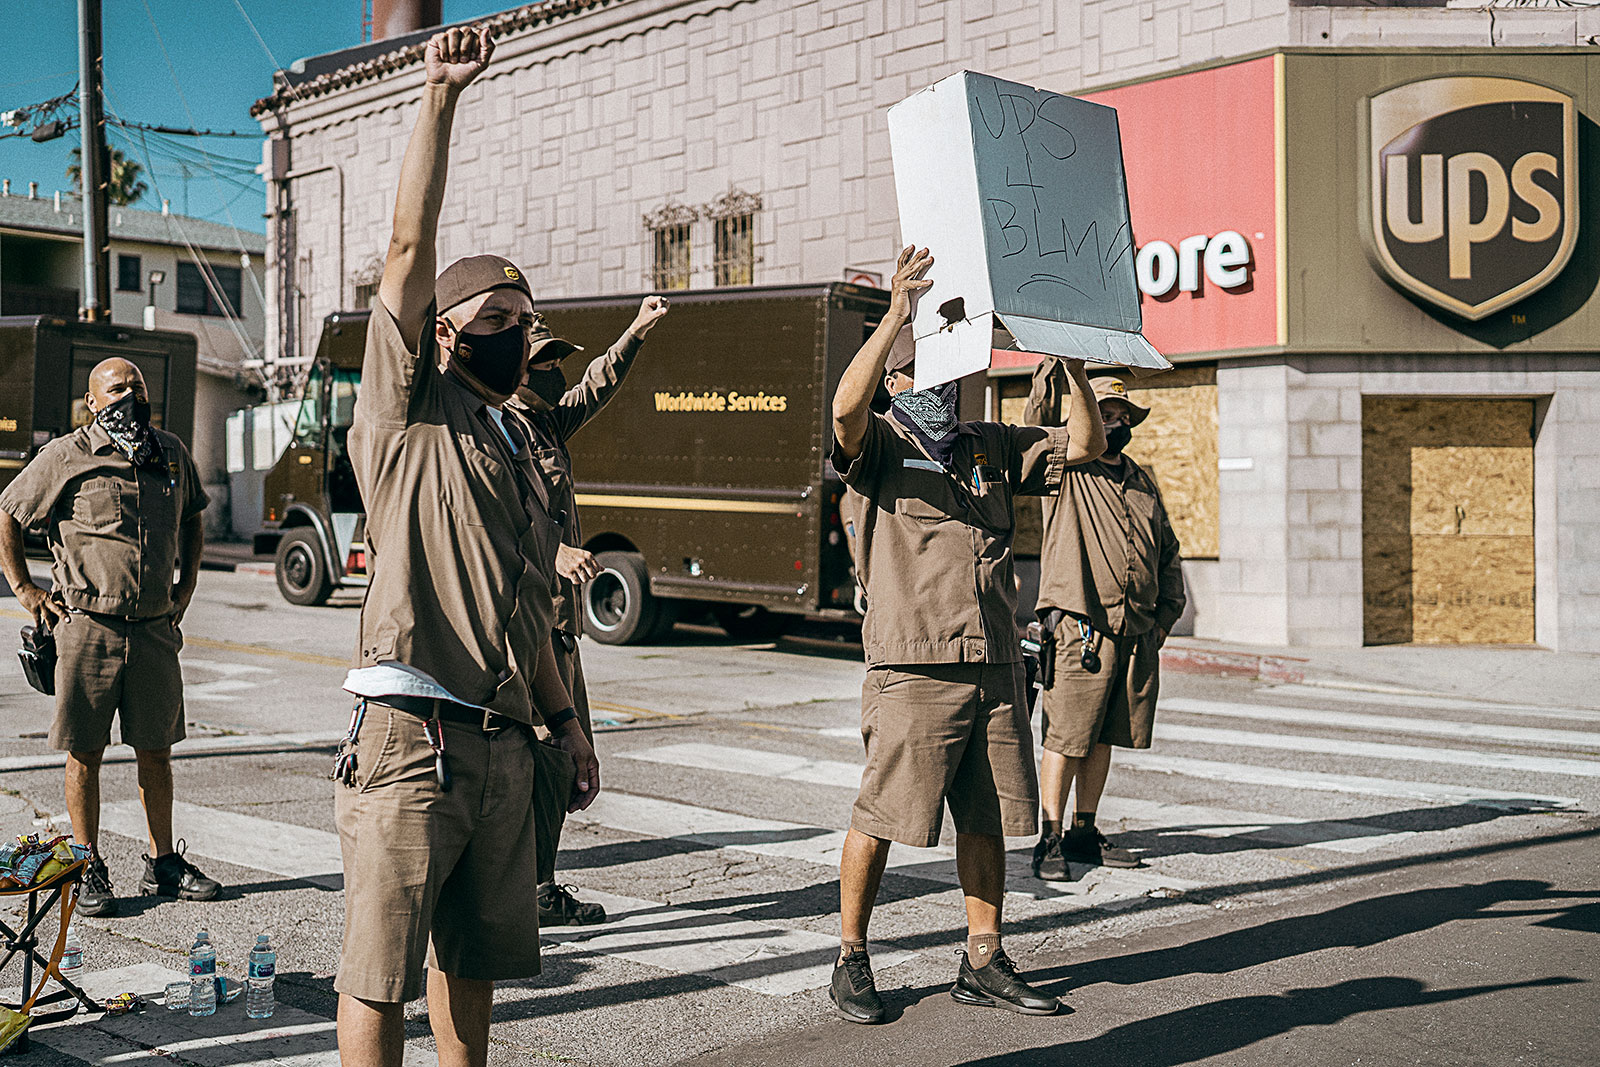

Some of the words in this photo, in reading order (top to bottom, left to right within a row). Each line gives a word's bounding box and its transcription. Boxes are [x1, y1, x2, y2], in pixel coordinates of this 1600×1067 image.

[975, 81, 1077, 164] UPS
[1006, 152, 1045, 213] 4
[1385, 151, 1561, 279] ups
[1135, 230, 1250, 297] ore
[654, 391, 726, 412] Worldwide
[727, 391, 788, 412] Services
